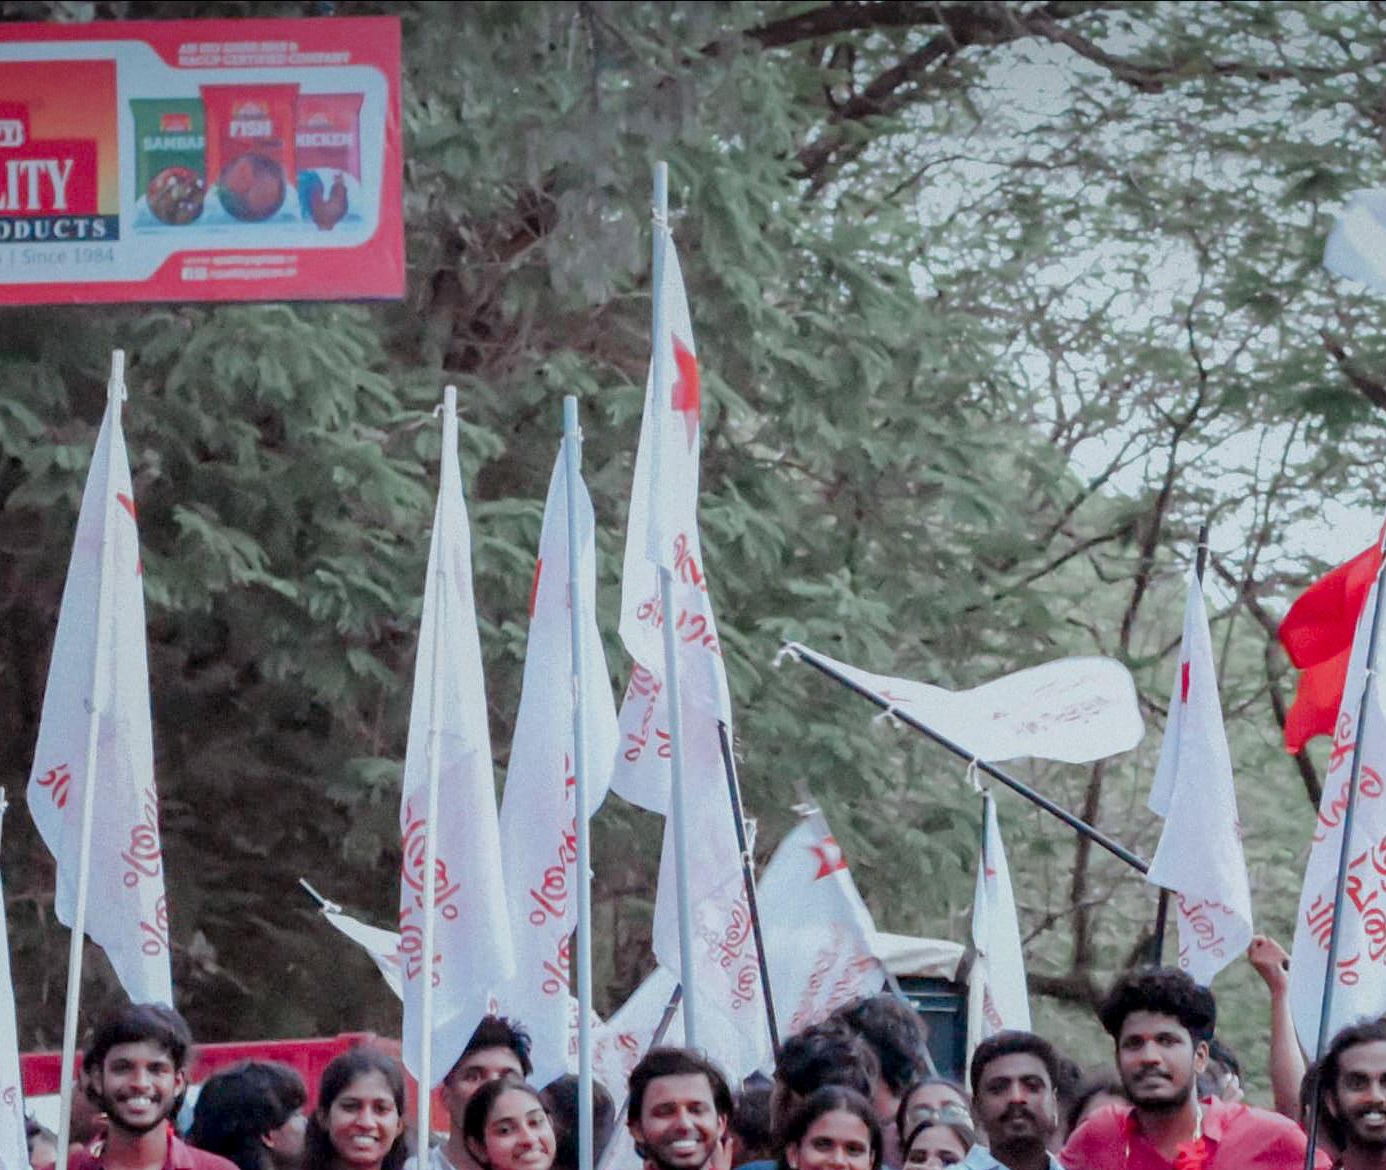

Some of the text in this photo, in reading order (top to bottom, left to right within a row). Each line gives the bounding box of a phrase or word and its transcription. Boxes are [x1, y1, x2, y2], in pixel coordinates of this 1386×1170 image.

[229, 120, 272, 137] FISH
[22, 248, 70, 265] Since
[73, 246, 115, 264] 1984
